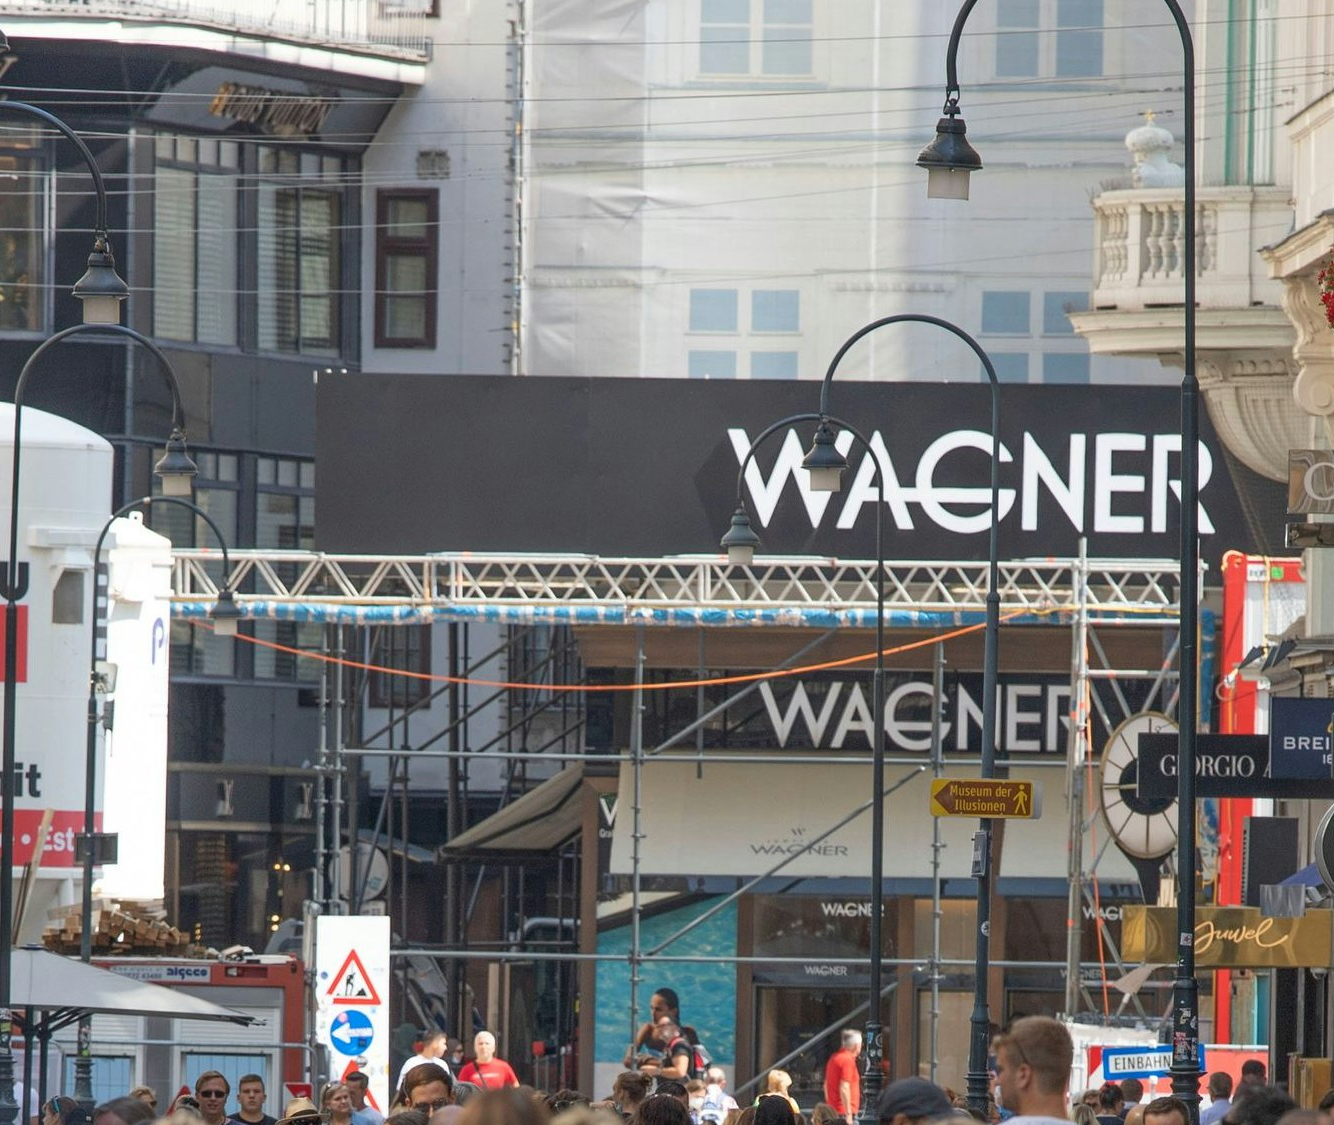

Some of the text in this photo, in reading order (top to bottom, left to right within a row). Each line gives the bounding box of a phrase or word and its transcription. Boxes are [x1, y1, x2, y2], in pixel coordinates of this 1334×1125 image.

[727, 428, 1215, 534] WAGNER
[950, 785, 1011, 797] Museum der
[955, 799, 1006, 811] Illusionen
[804, 965, 848, 976] WAGNER
[1114, 1055, 1172, 1070] EINBAHN
